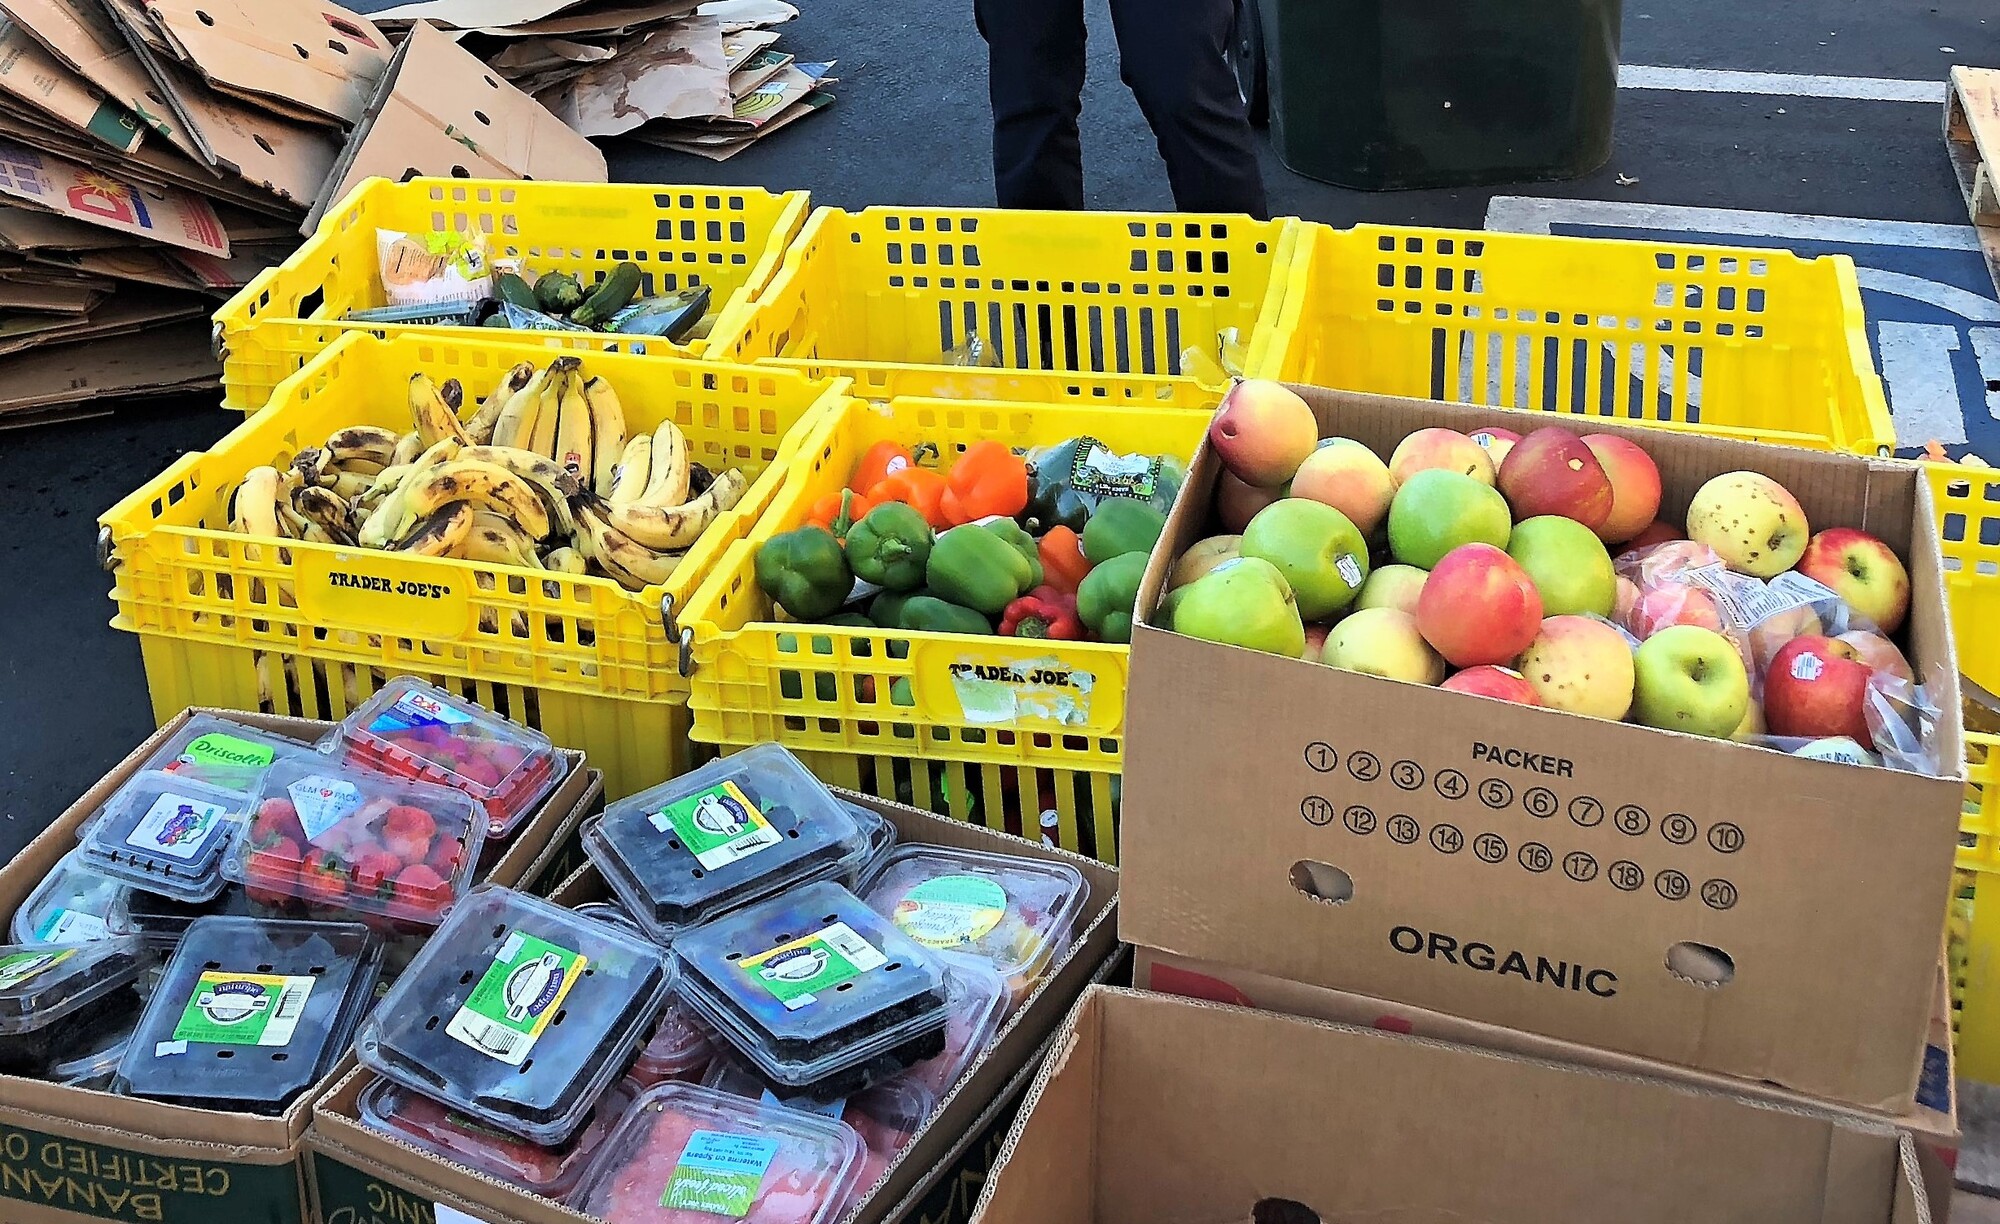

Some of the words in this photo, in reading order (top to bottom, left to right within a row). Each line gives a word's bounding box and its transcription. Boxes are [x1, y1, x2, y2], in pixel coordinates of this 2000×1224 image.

[328, 572, 392, 593] TRADER
[1472, 742, 1574, 778] PACKER
[1389, 925, 1618, 998] ORGANIC
[0, 1132, 29, 1161] O
[41, 1142, 231, 1196] CERTIFIED
